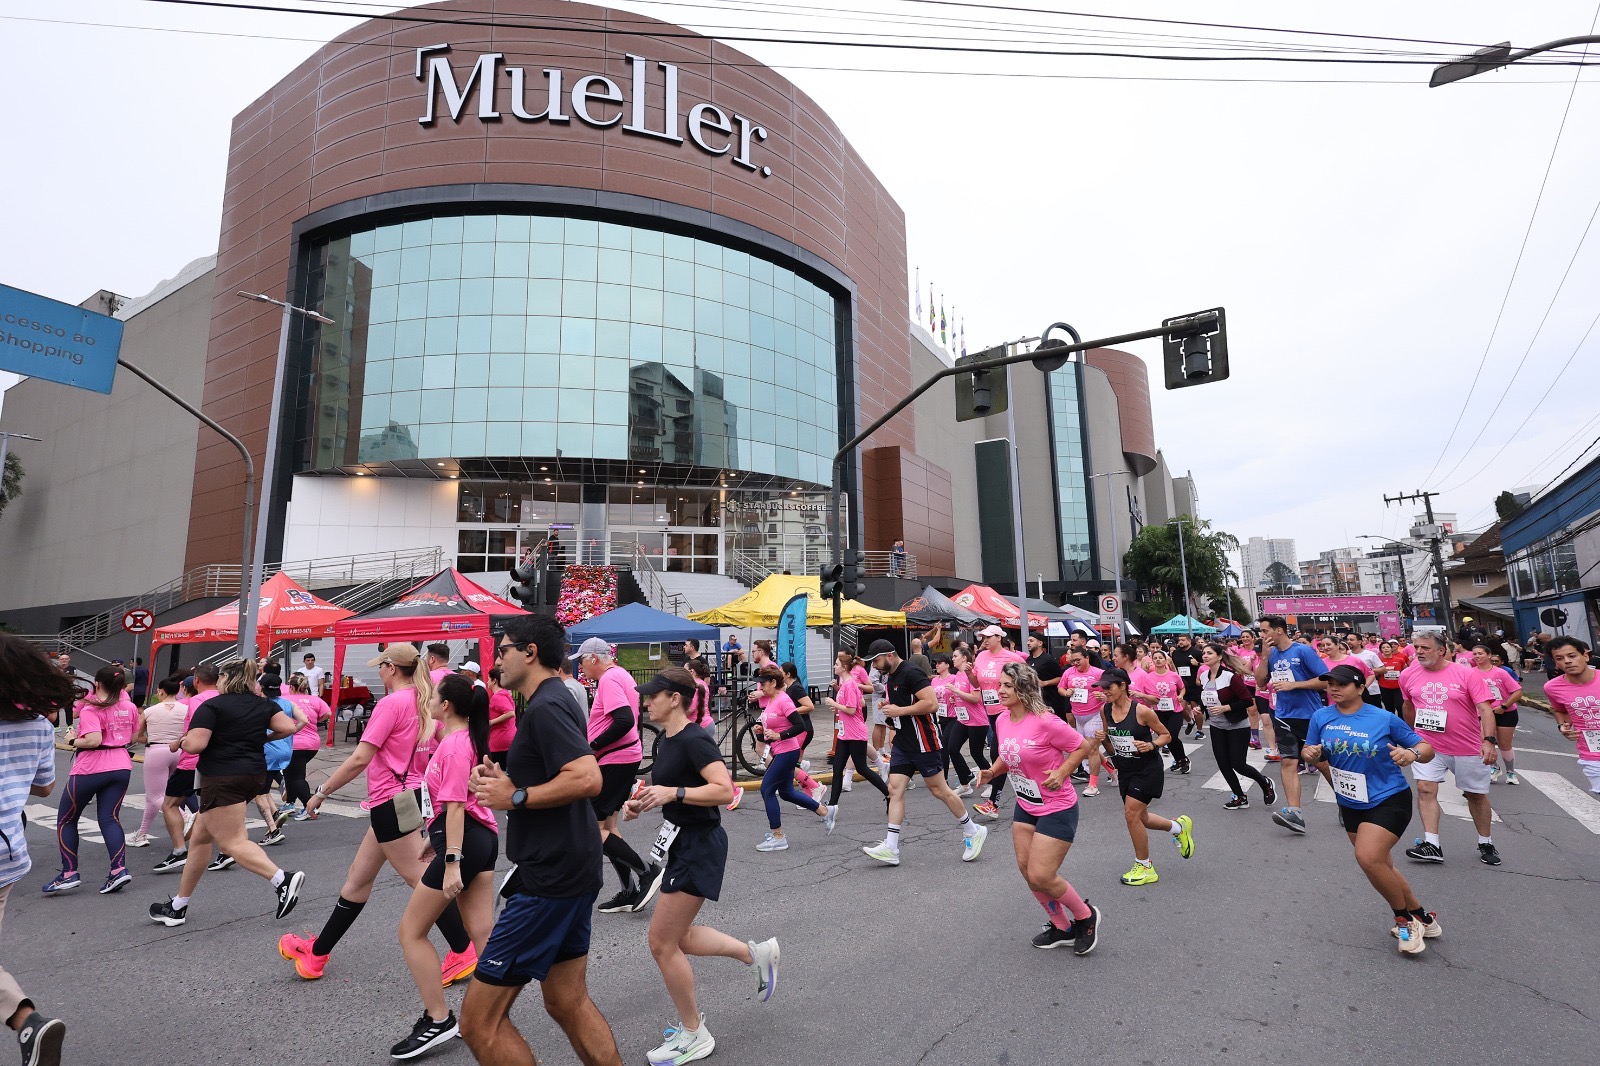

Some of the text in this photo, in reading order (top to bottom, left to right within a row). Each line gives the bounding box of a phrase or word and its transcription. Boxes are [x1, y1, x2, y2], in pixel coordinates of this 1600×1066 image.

[0, 311, 96, 346] cesso ao
[743, 502, 796, 511] STARBUCKS
[1106, 599, 1114, 609] E
[1421, 718, 1441, 726] 1195
[1018, 785, 1035, 797] 1416
[1339, 781, 1357, 792] 512
[278, 885, 288, 903] FILA
